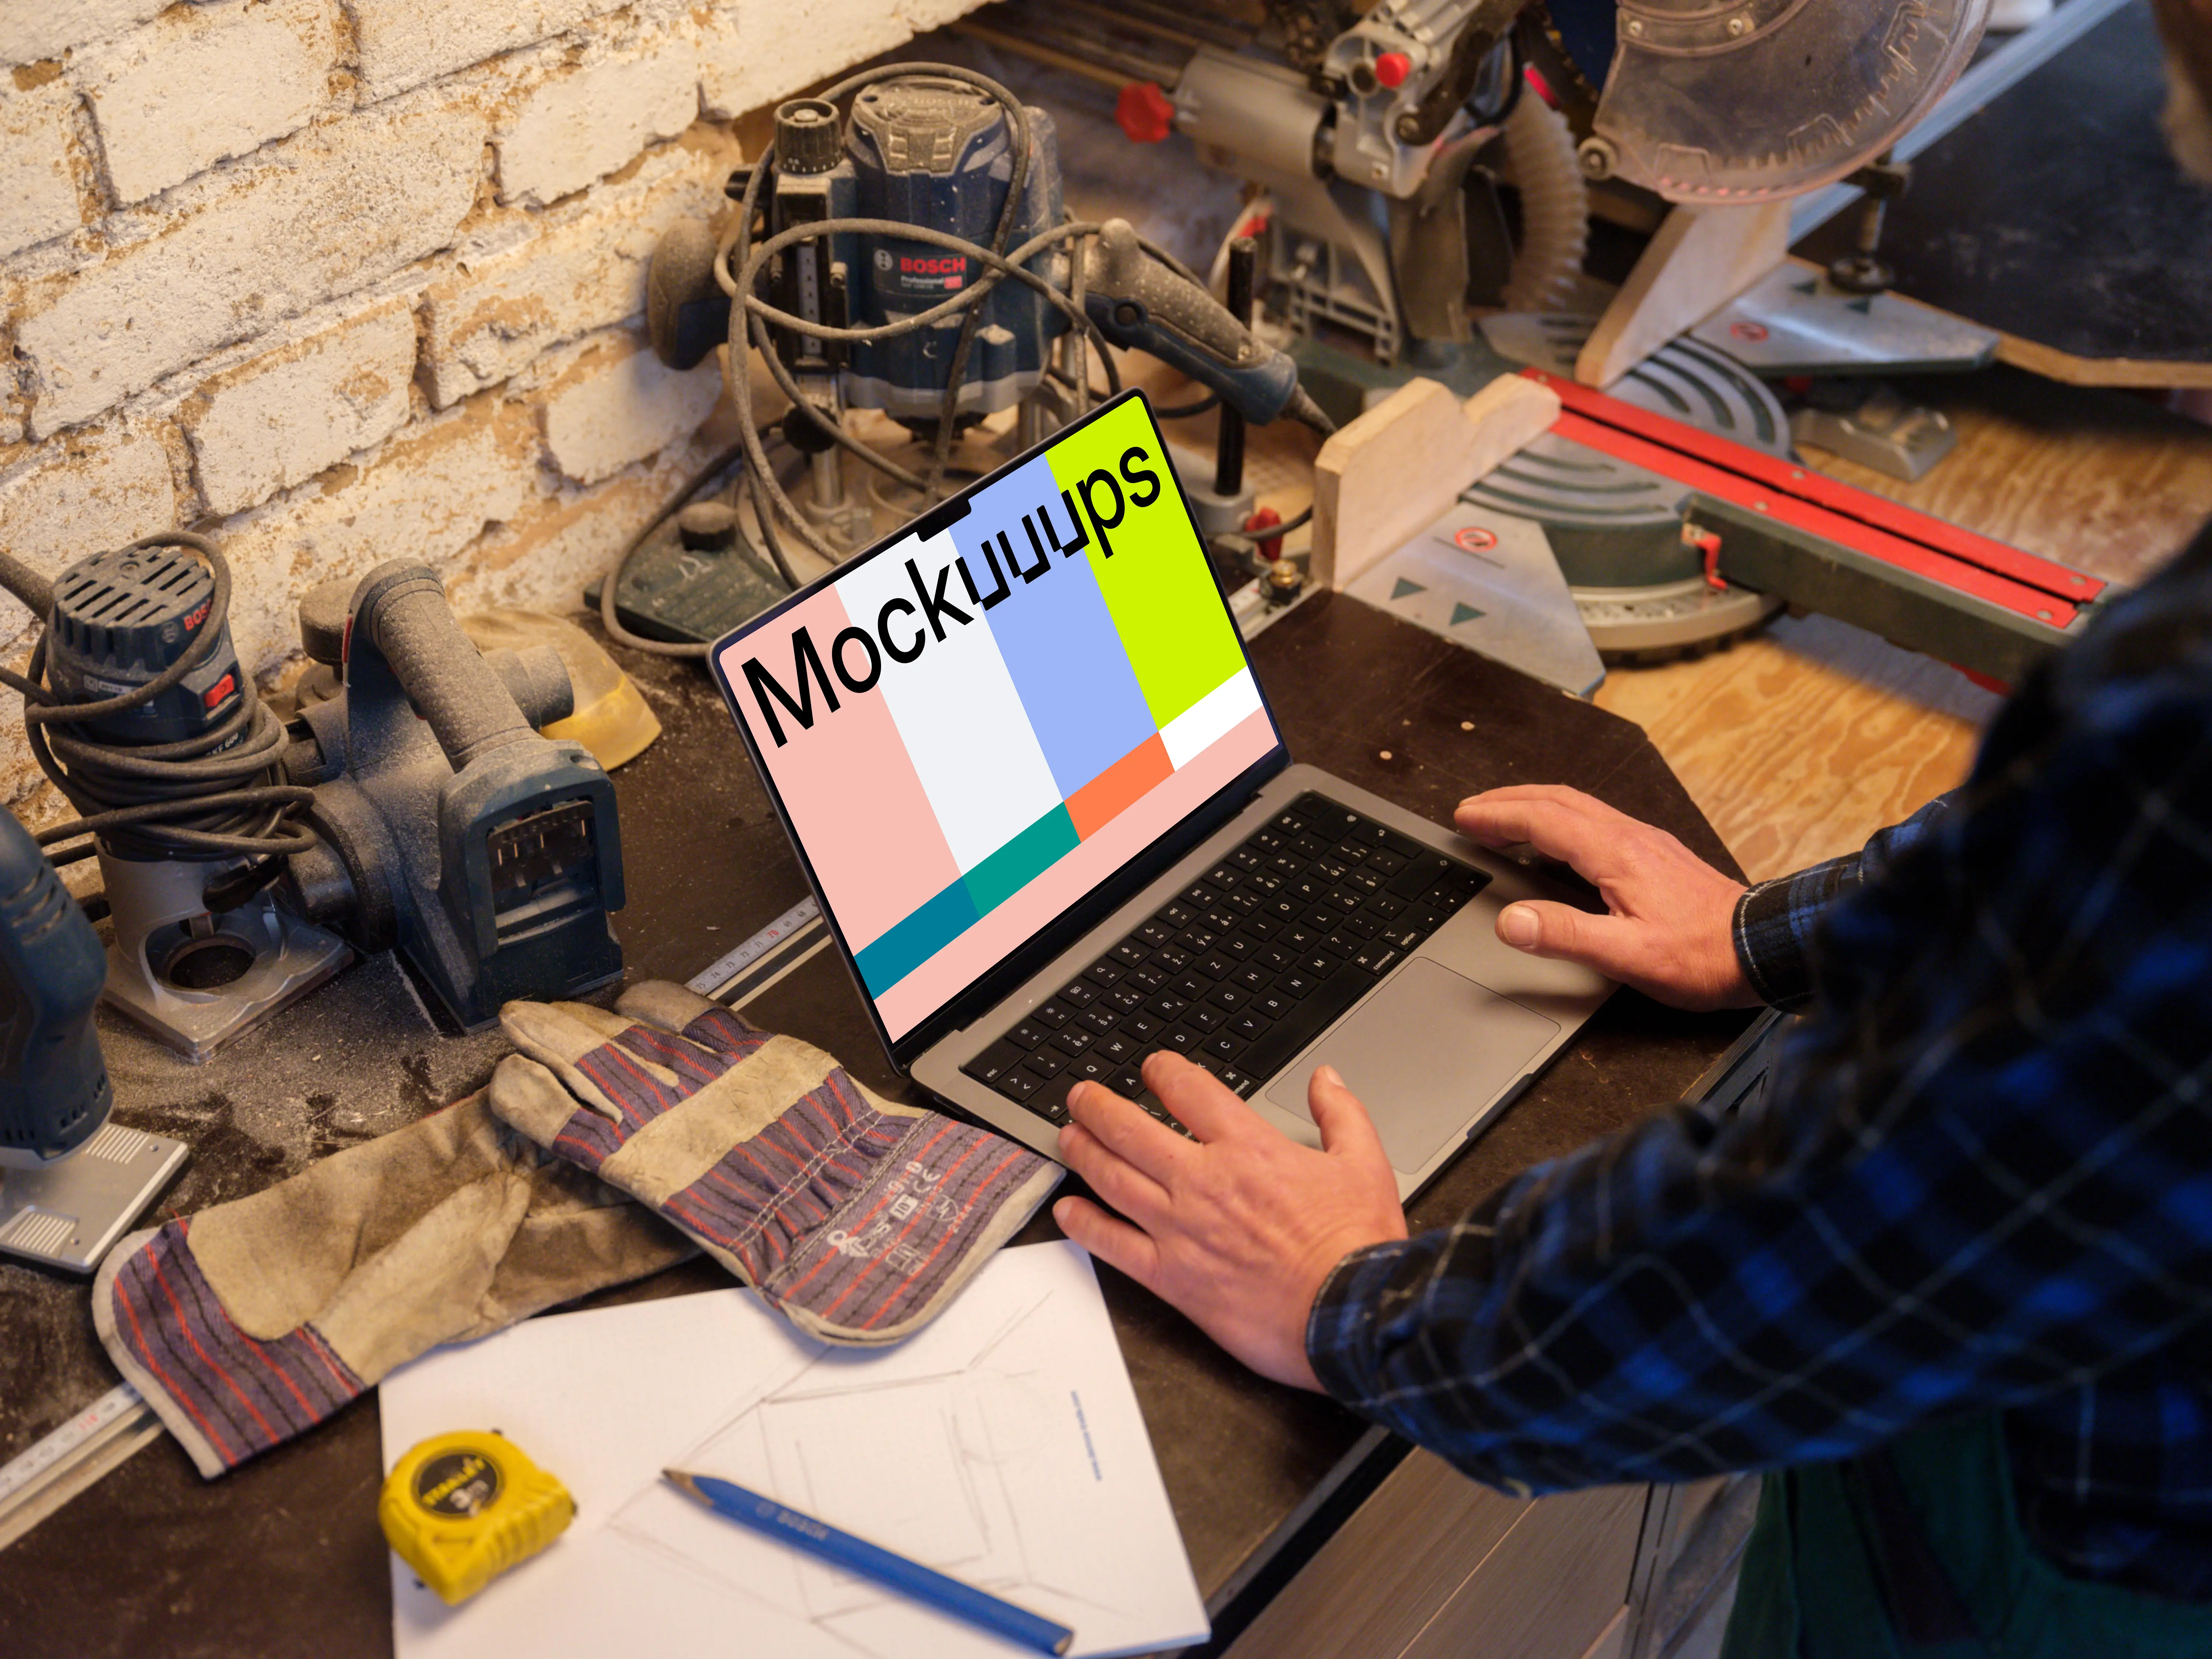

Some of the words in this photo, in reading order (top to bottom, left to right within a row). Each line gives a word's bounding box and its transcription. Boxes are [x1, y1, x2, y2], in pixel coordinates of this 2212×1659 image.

[900, 257, 966, 274] BOSCH
[741, 446, 1161, 747] Mockuuups
[184, 598, 212, 632] BOS
[766, 929, 780, 939] 70
[1401, 933, 1416, 945] option
[754, 940, 764, 949] 71
[739, 950, 750, 959] 72
[1314, 959, 1325, 967] M
[1373, 950, 1395, 970] command
[725, 961, 736, 969] 73
[710, 971, 721, 980] 74
[696, 982, 706, 990] 75
[1110, 1043, 1122, 1051] W
[987, 1069, 997, 1077] esc
